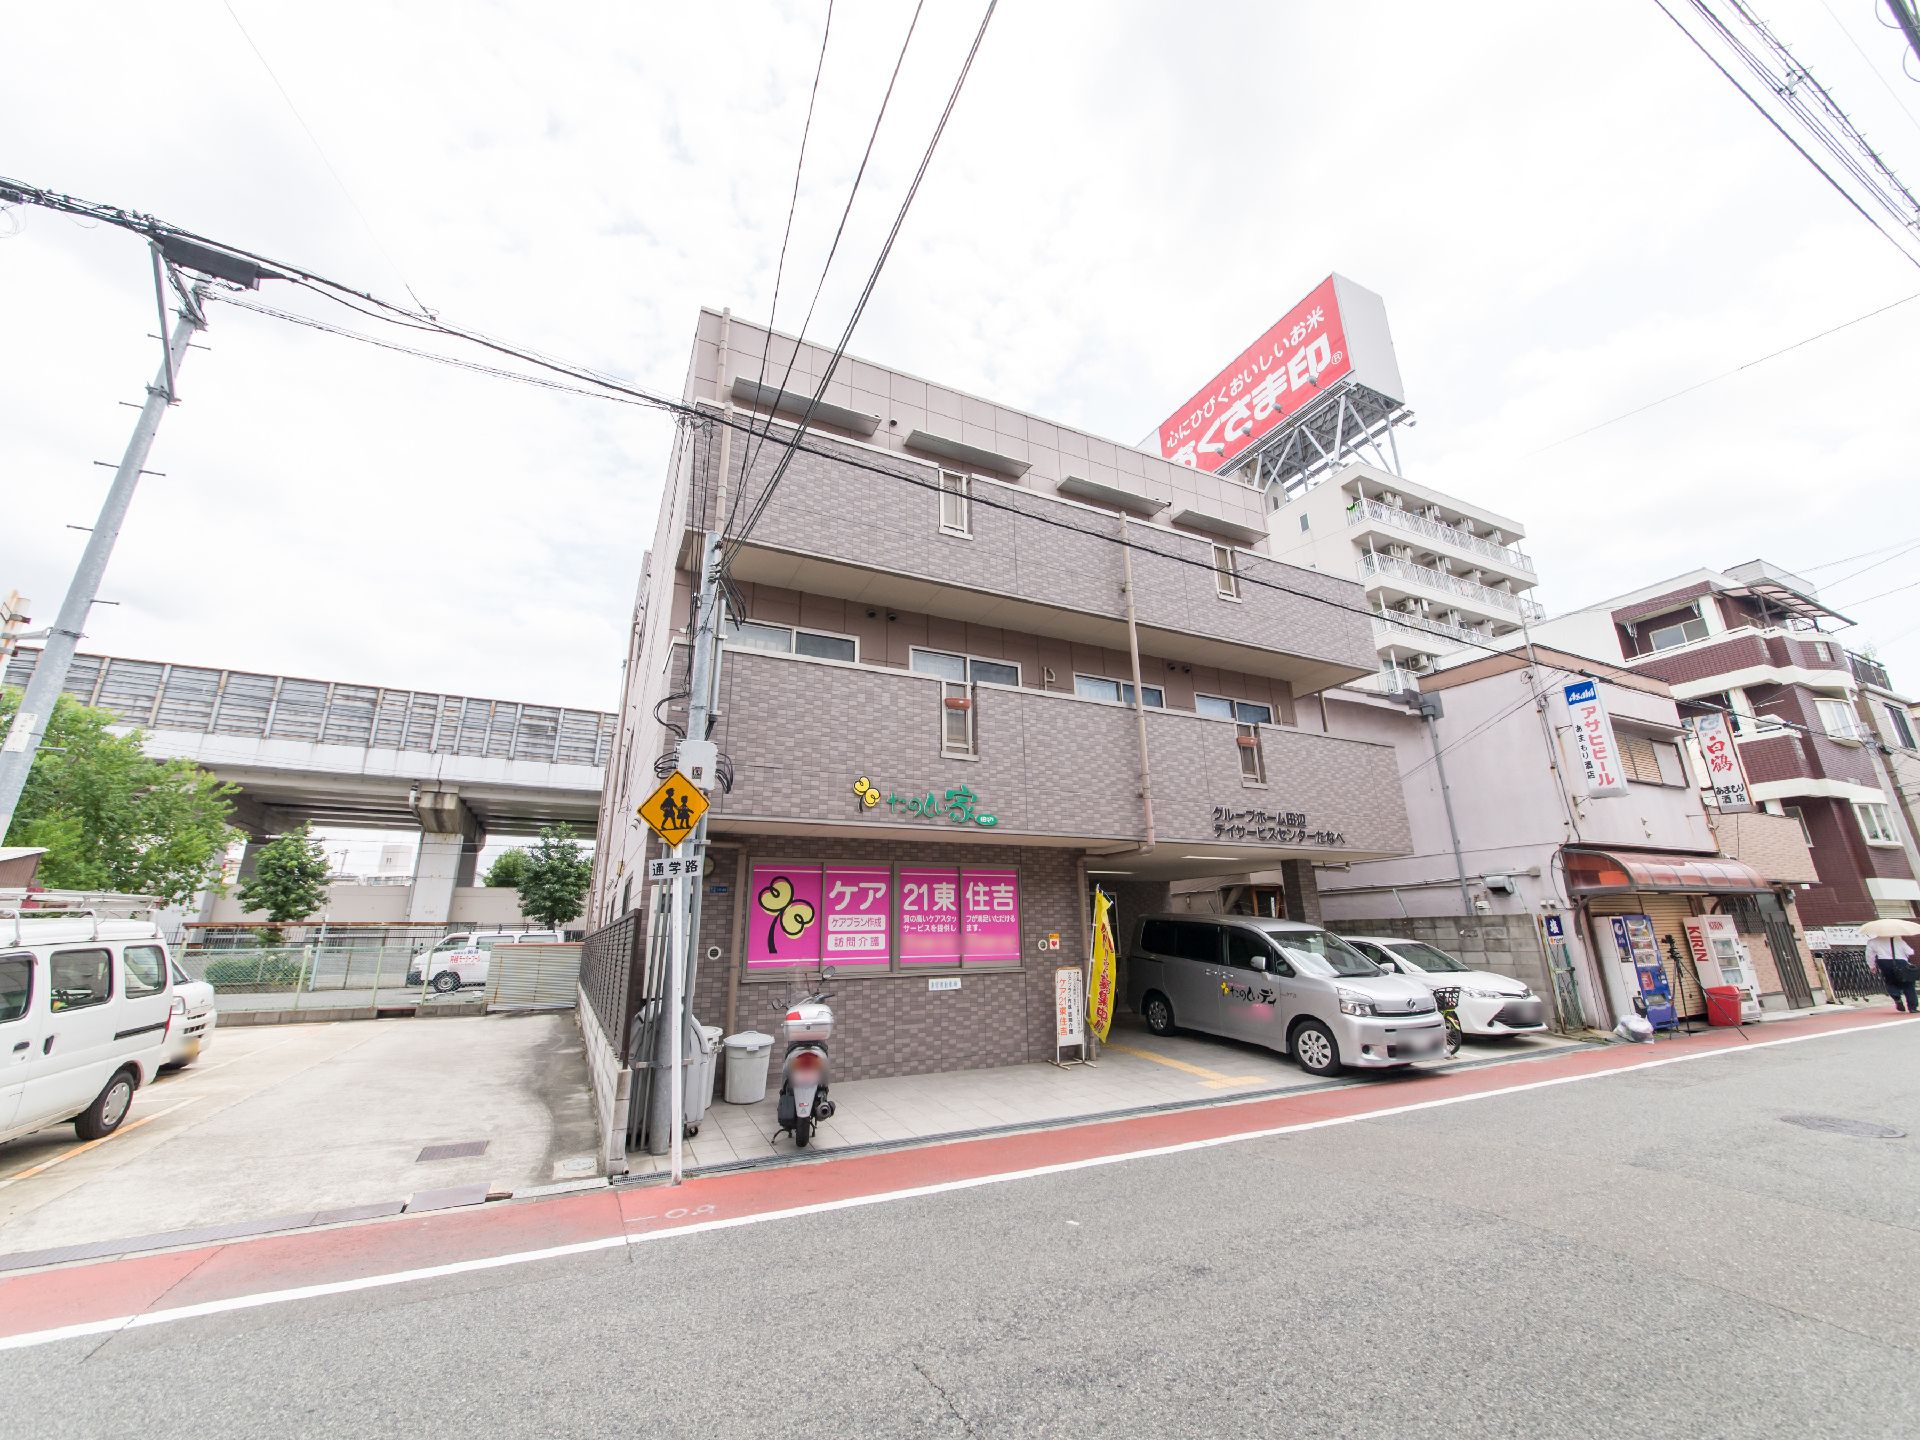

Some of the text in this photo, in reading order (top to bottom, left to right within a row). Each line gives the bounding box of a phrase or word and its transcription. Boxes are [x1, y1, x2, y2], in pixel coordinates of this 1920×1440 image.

[1167, 306, 1325, 448] 心にひびくおいしいお米
[1568, 687, 1595, 702] Asahi
[1575, 724, 1596, 780] あまもり酒店
[1581, 705, 1615, 786] アサヒビール
[1707, 735, 1734, 773] 白鶴
[1715, 783, 1745, 795] あまもり
[1721, 793, 1746, 804] 酒店
[886, 784, 978, 823] たのしい家
[1212, 806, 1307, 829] グループホーム田辺
[652, 860, 698, 876] 通学路
[831, 916, 882, 929] ケアプラン作成
[833, 936, 880, 948] 訪問介護
[1687, 926, 1709, 962] KIRIN
